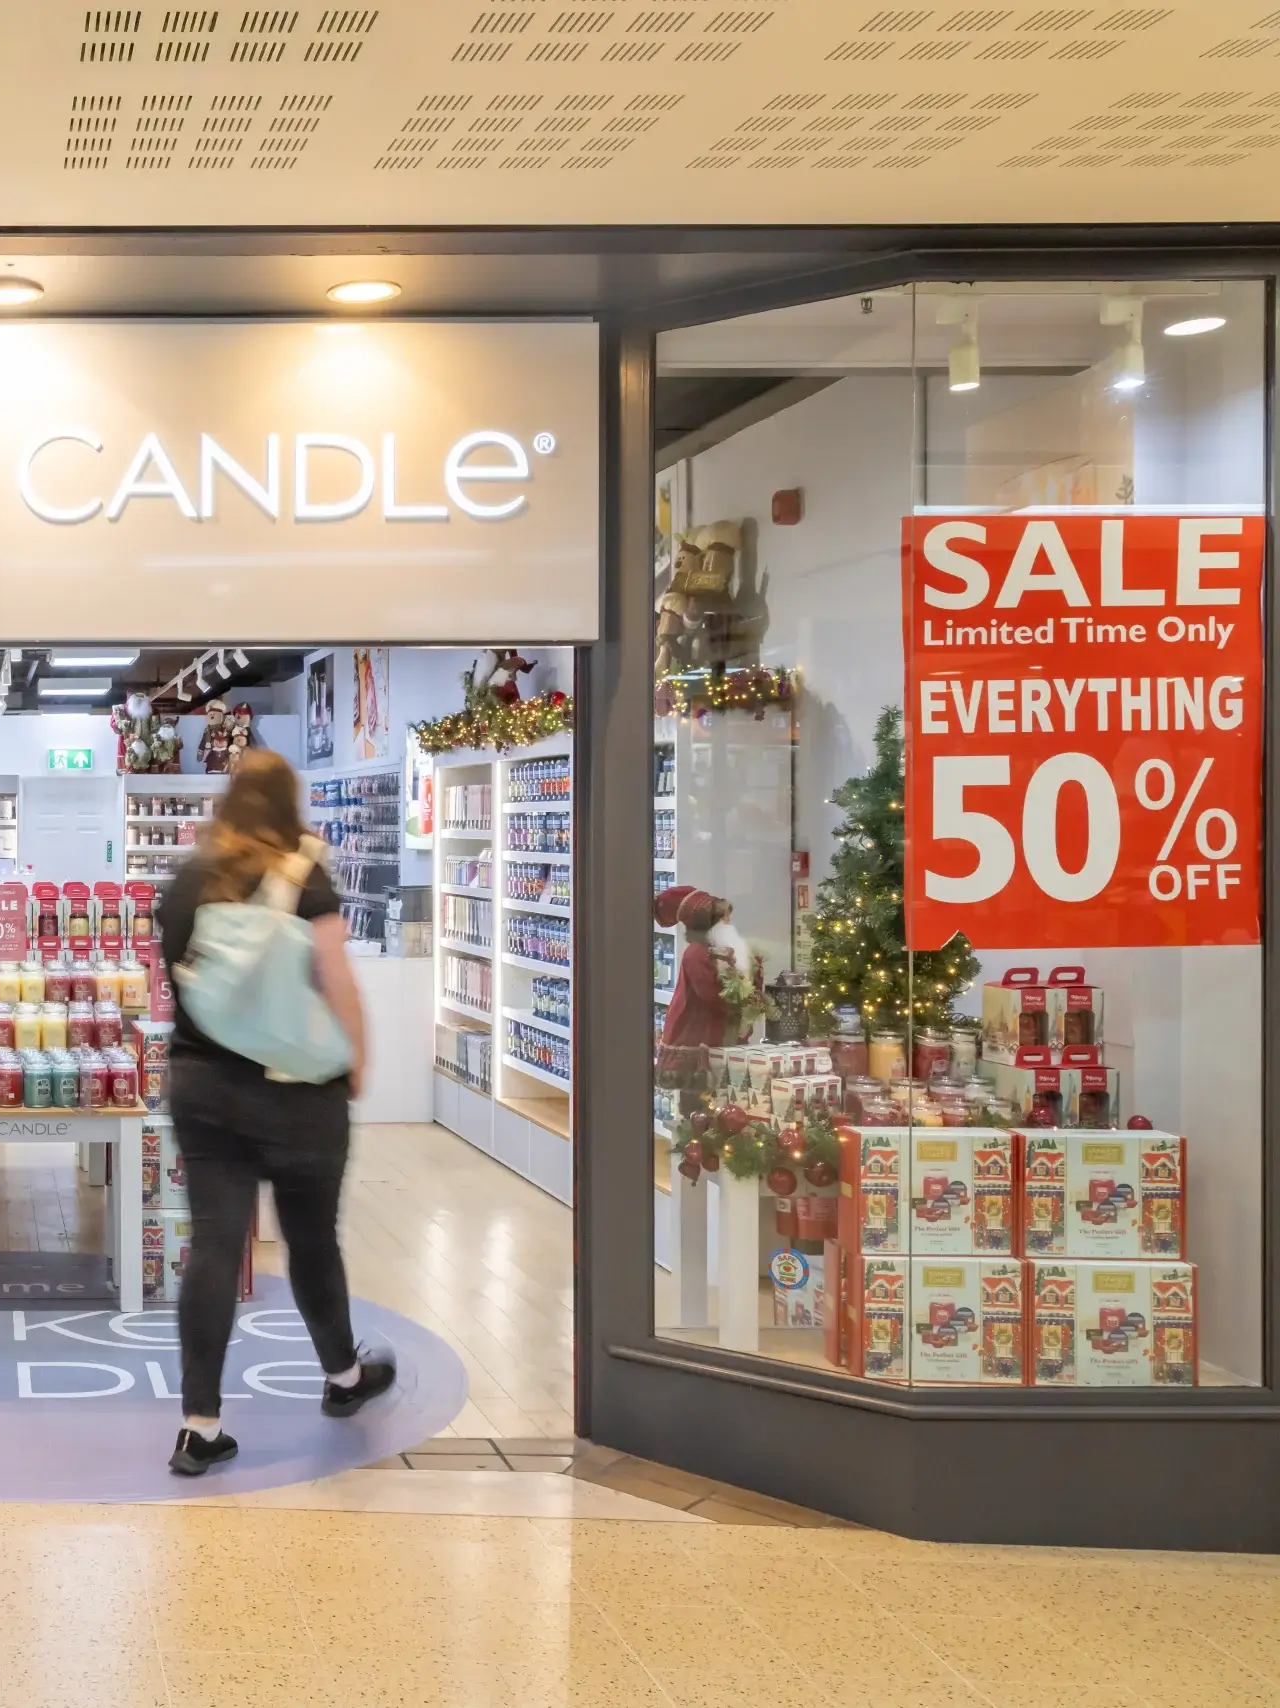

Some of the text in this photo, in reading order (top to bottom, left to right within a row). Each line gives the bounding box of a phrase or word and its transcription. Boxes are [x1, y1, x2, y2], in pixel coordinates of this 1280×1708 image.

[923, 518, 1243, 610] SALE
[923, 615, 1235, 649] Limited Time Only
[920, 675, 1245, 734] EVERYTHING
[925, 752, 1238, 903] 50%
[1148, 864, 1242, 901] OFF
